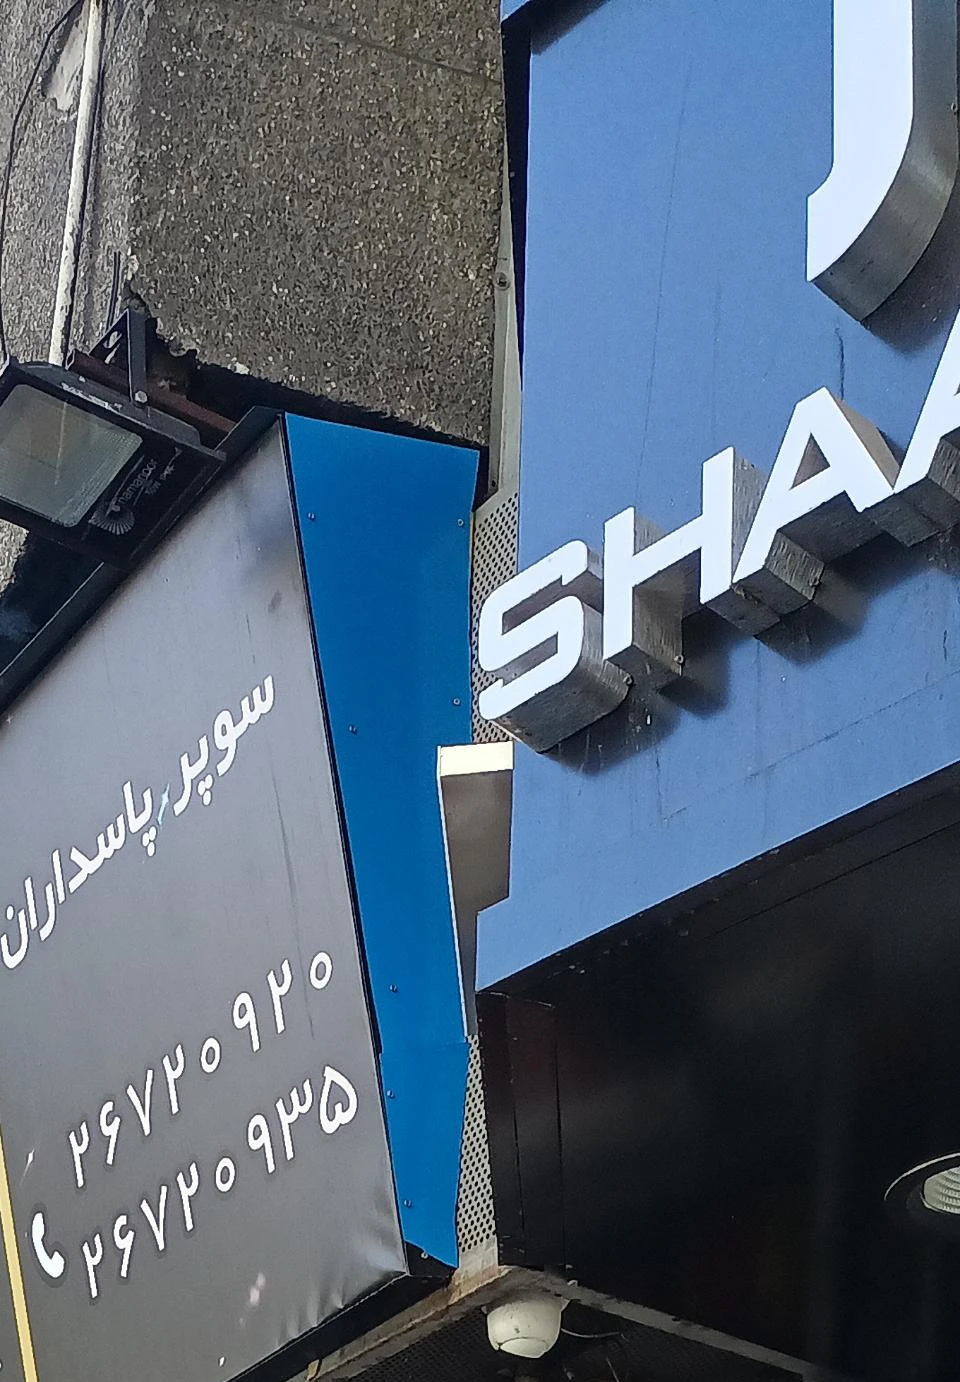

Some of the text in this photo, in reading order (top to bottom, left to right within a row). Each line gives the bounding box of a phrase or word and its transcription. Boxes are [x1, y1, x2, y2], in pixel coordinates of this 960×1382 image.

[0, 674, 276, 970] سوپر پاسداران
[68, 951, 333, 1187] ۲۶۷۲۰۹۲۰
[82, 1066, 357, 1299] ۲۶۷۲۰۹۳۵
